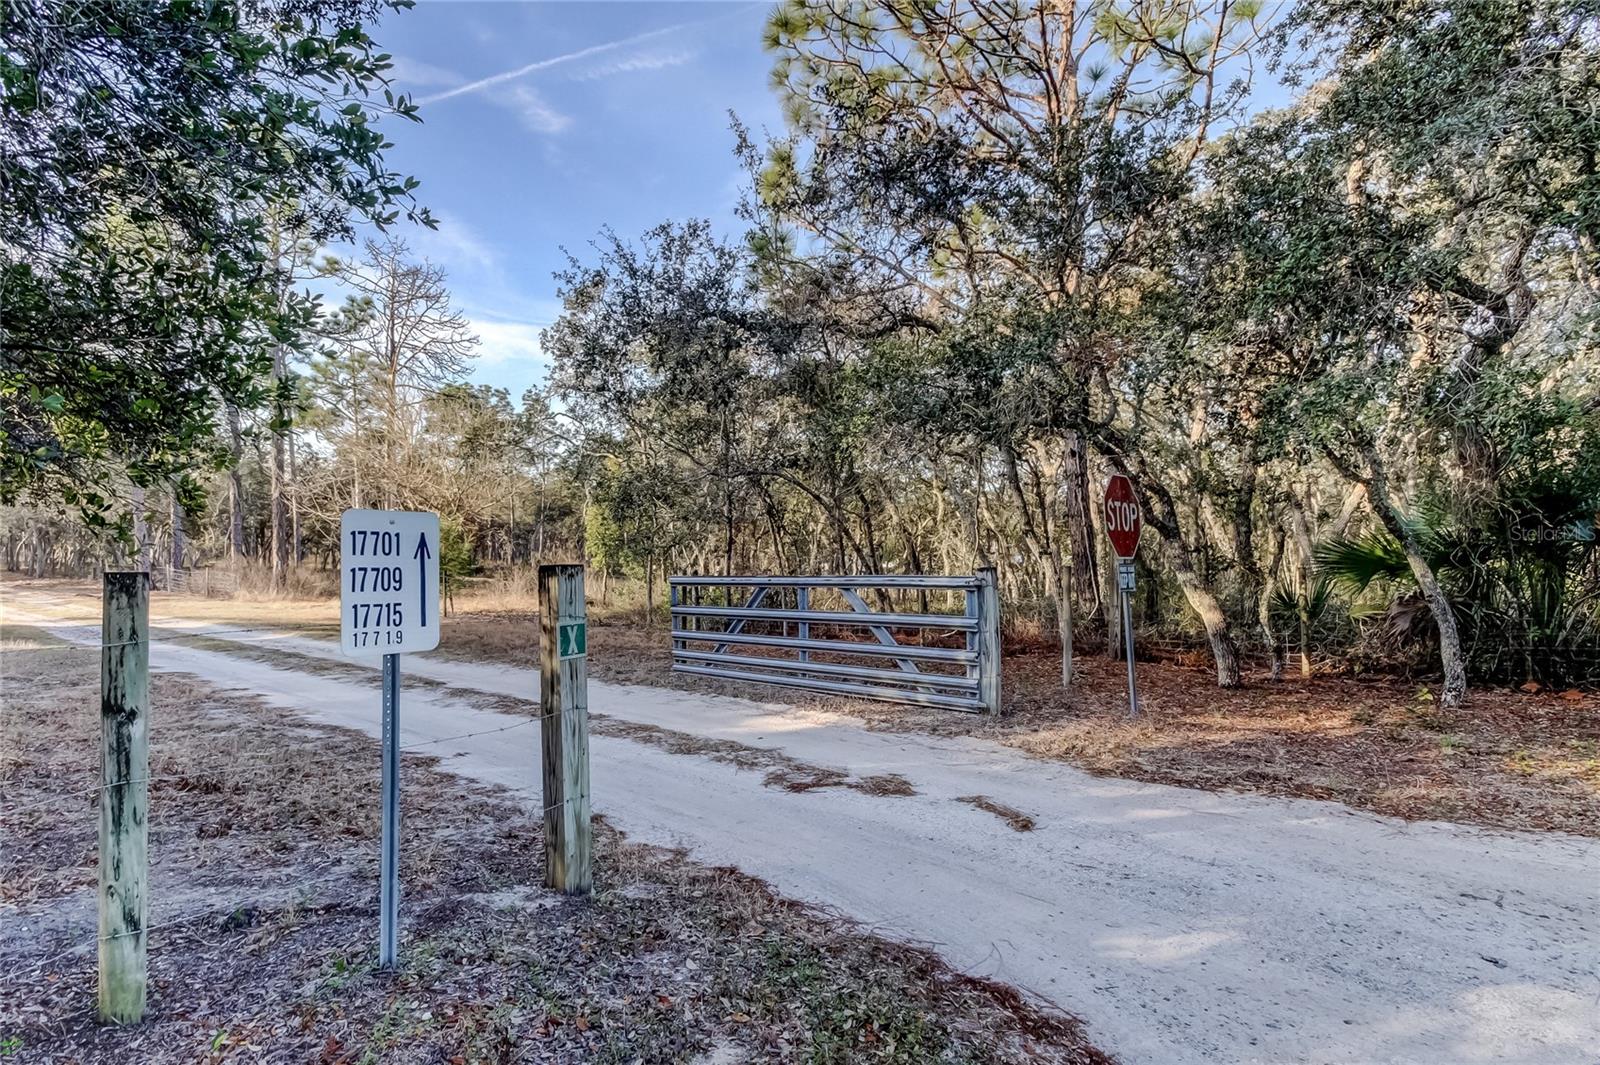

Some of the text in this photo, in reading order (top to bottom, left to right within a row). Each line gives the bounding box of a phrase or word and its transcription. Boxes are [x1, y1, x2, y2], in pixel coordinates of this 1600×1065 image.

[1107, 498, 1138, 532] STOP
[350, 531, 400, 556] 17701
[350, 567, 403, 592] 17709
[352, 603, 403, 629] 17715
